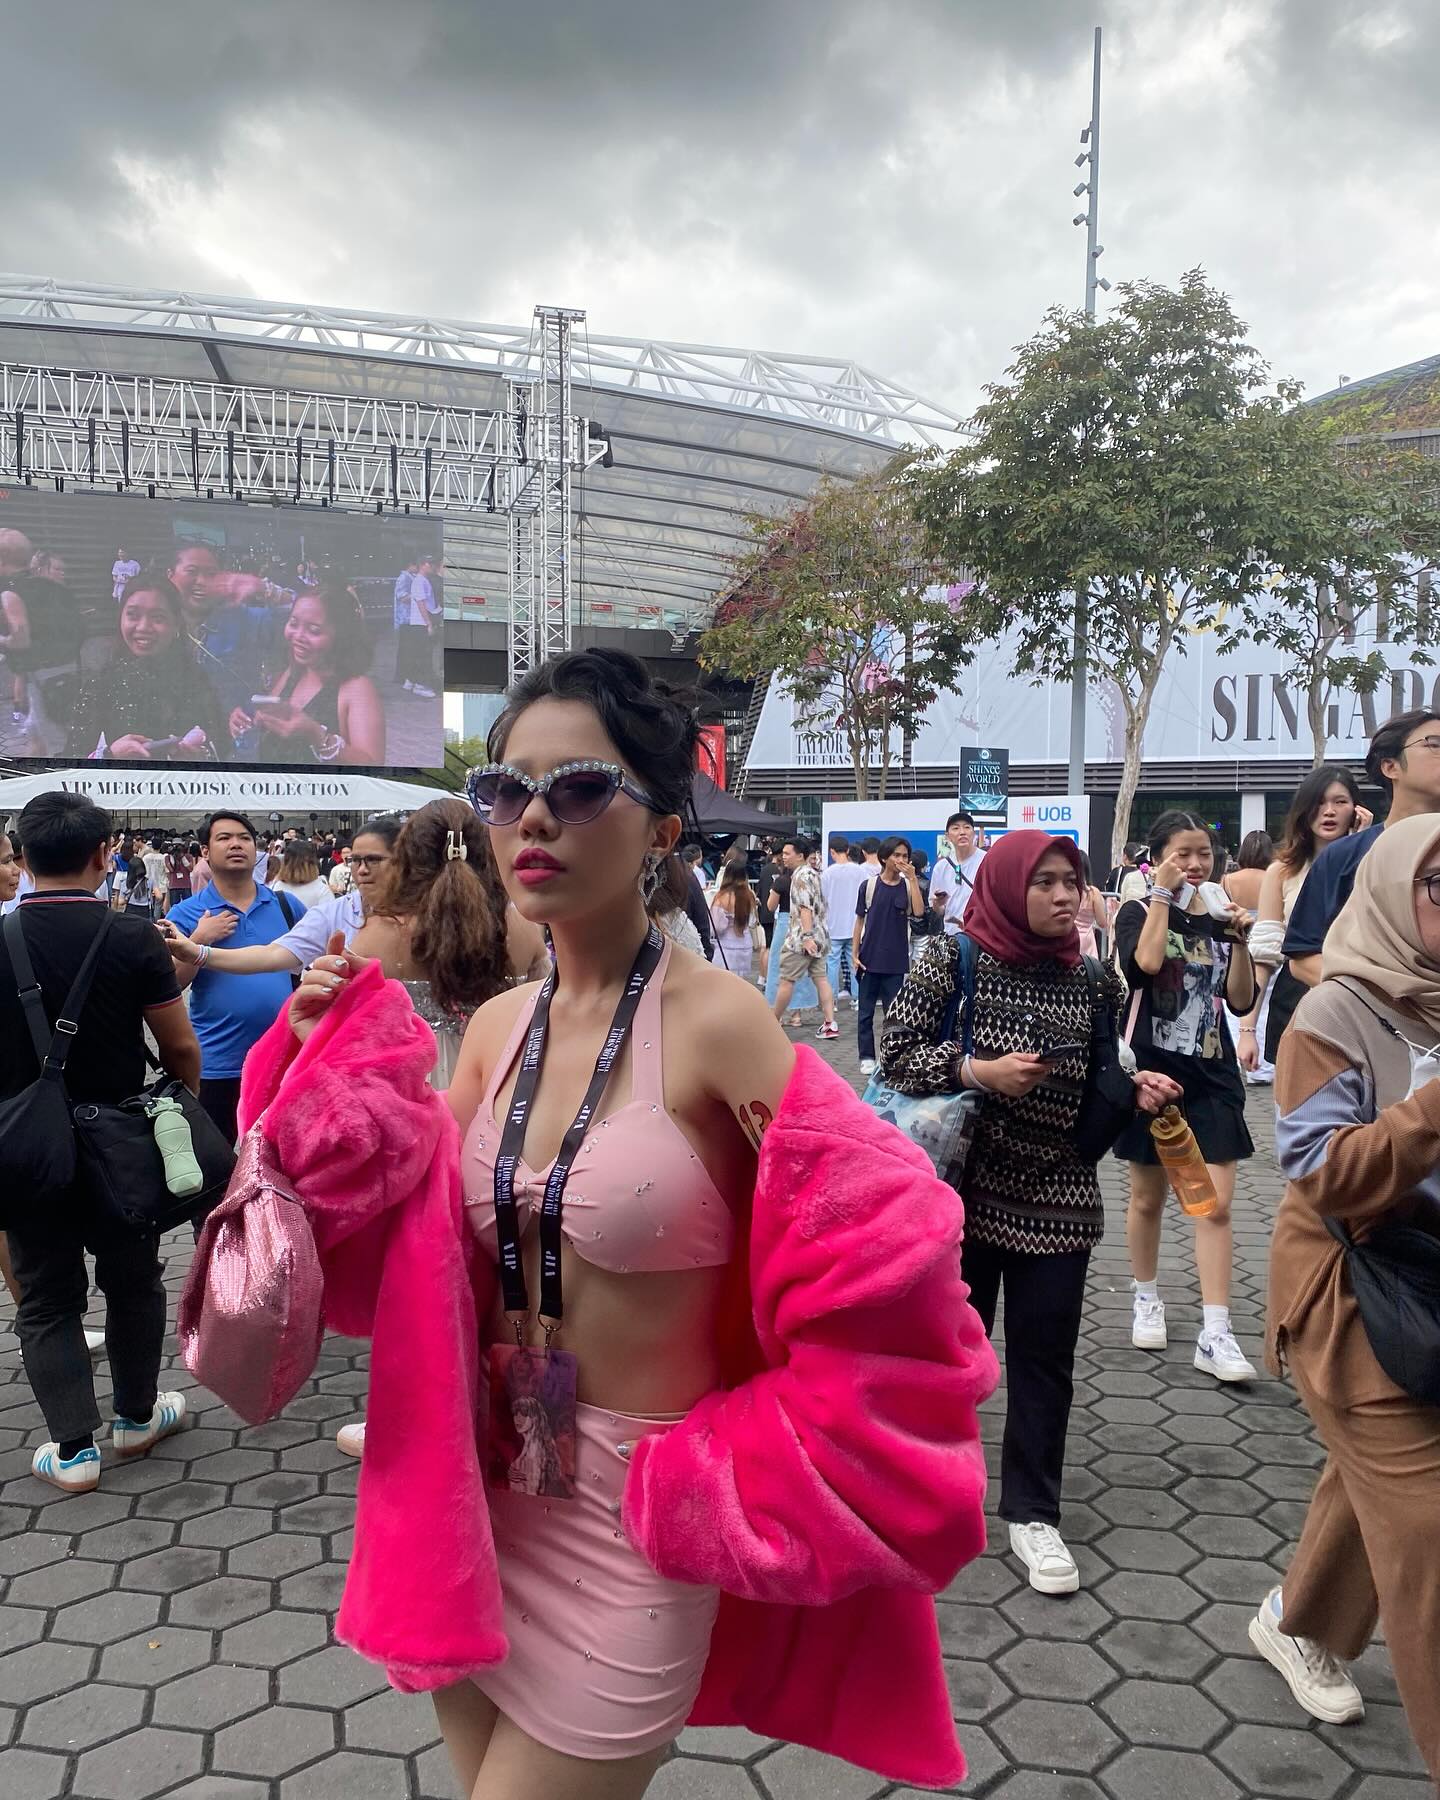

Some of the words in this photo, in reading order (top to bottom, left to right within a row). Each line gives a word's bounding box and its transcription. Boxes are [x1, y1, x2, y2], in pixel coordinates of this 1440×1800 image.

[796, 754, 819, 766] THE
[821, 754, 851, 766] ERAS
[61, 781, 92, 797] VIP
[97, 781, 231, 796] MERCHANDISE
[239, 782, 351, 797] COLLECTION
[967, 774, 1001, 784] WORLD
[1038, 806, 1072, 822] UOB
[628, 973, 645, 996] VIP
[512, 1100, 527, 1124] VIP
[574, 1105, 591, 1129] VIP
[503, 1242, 517, 1270] VIP
[544, 1250, 556, 1277] VIP
